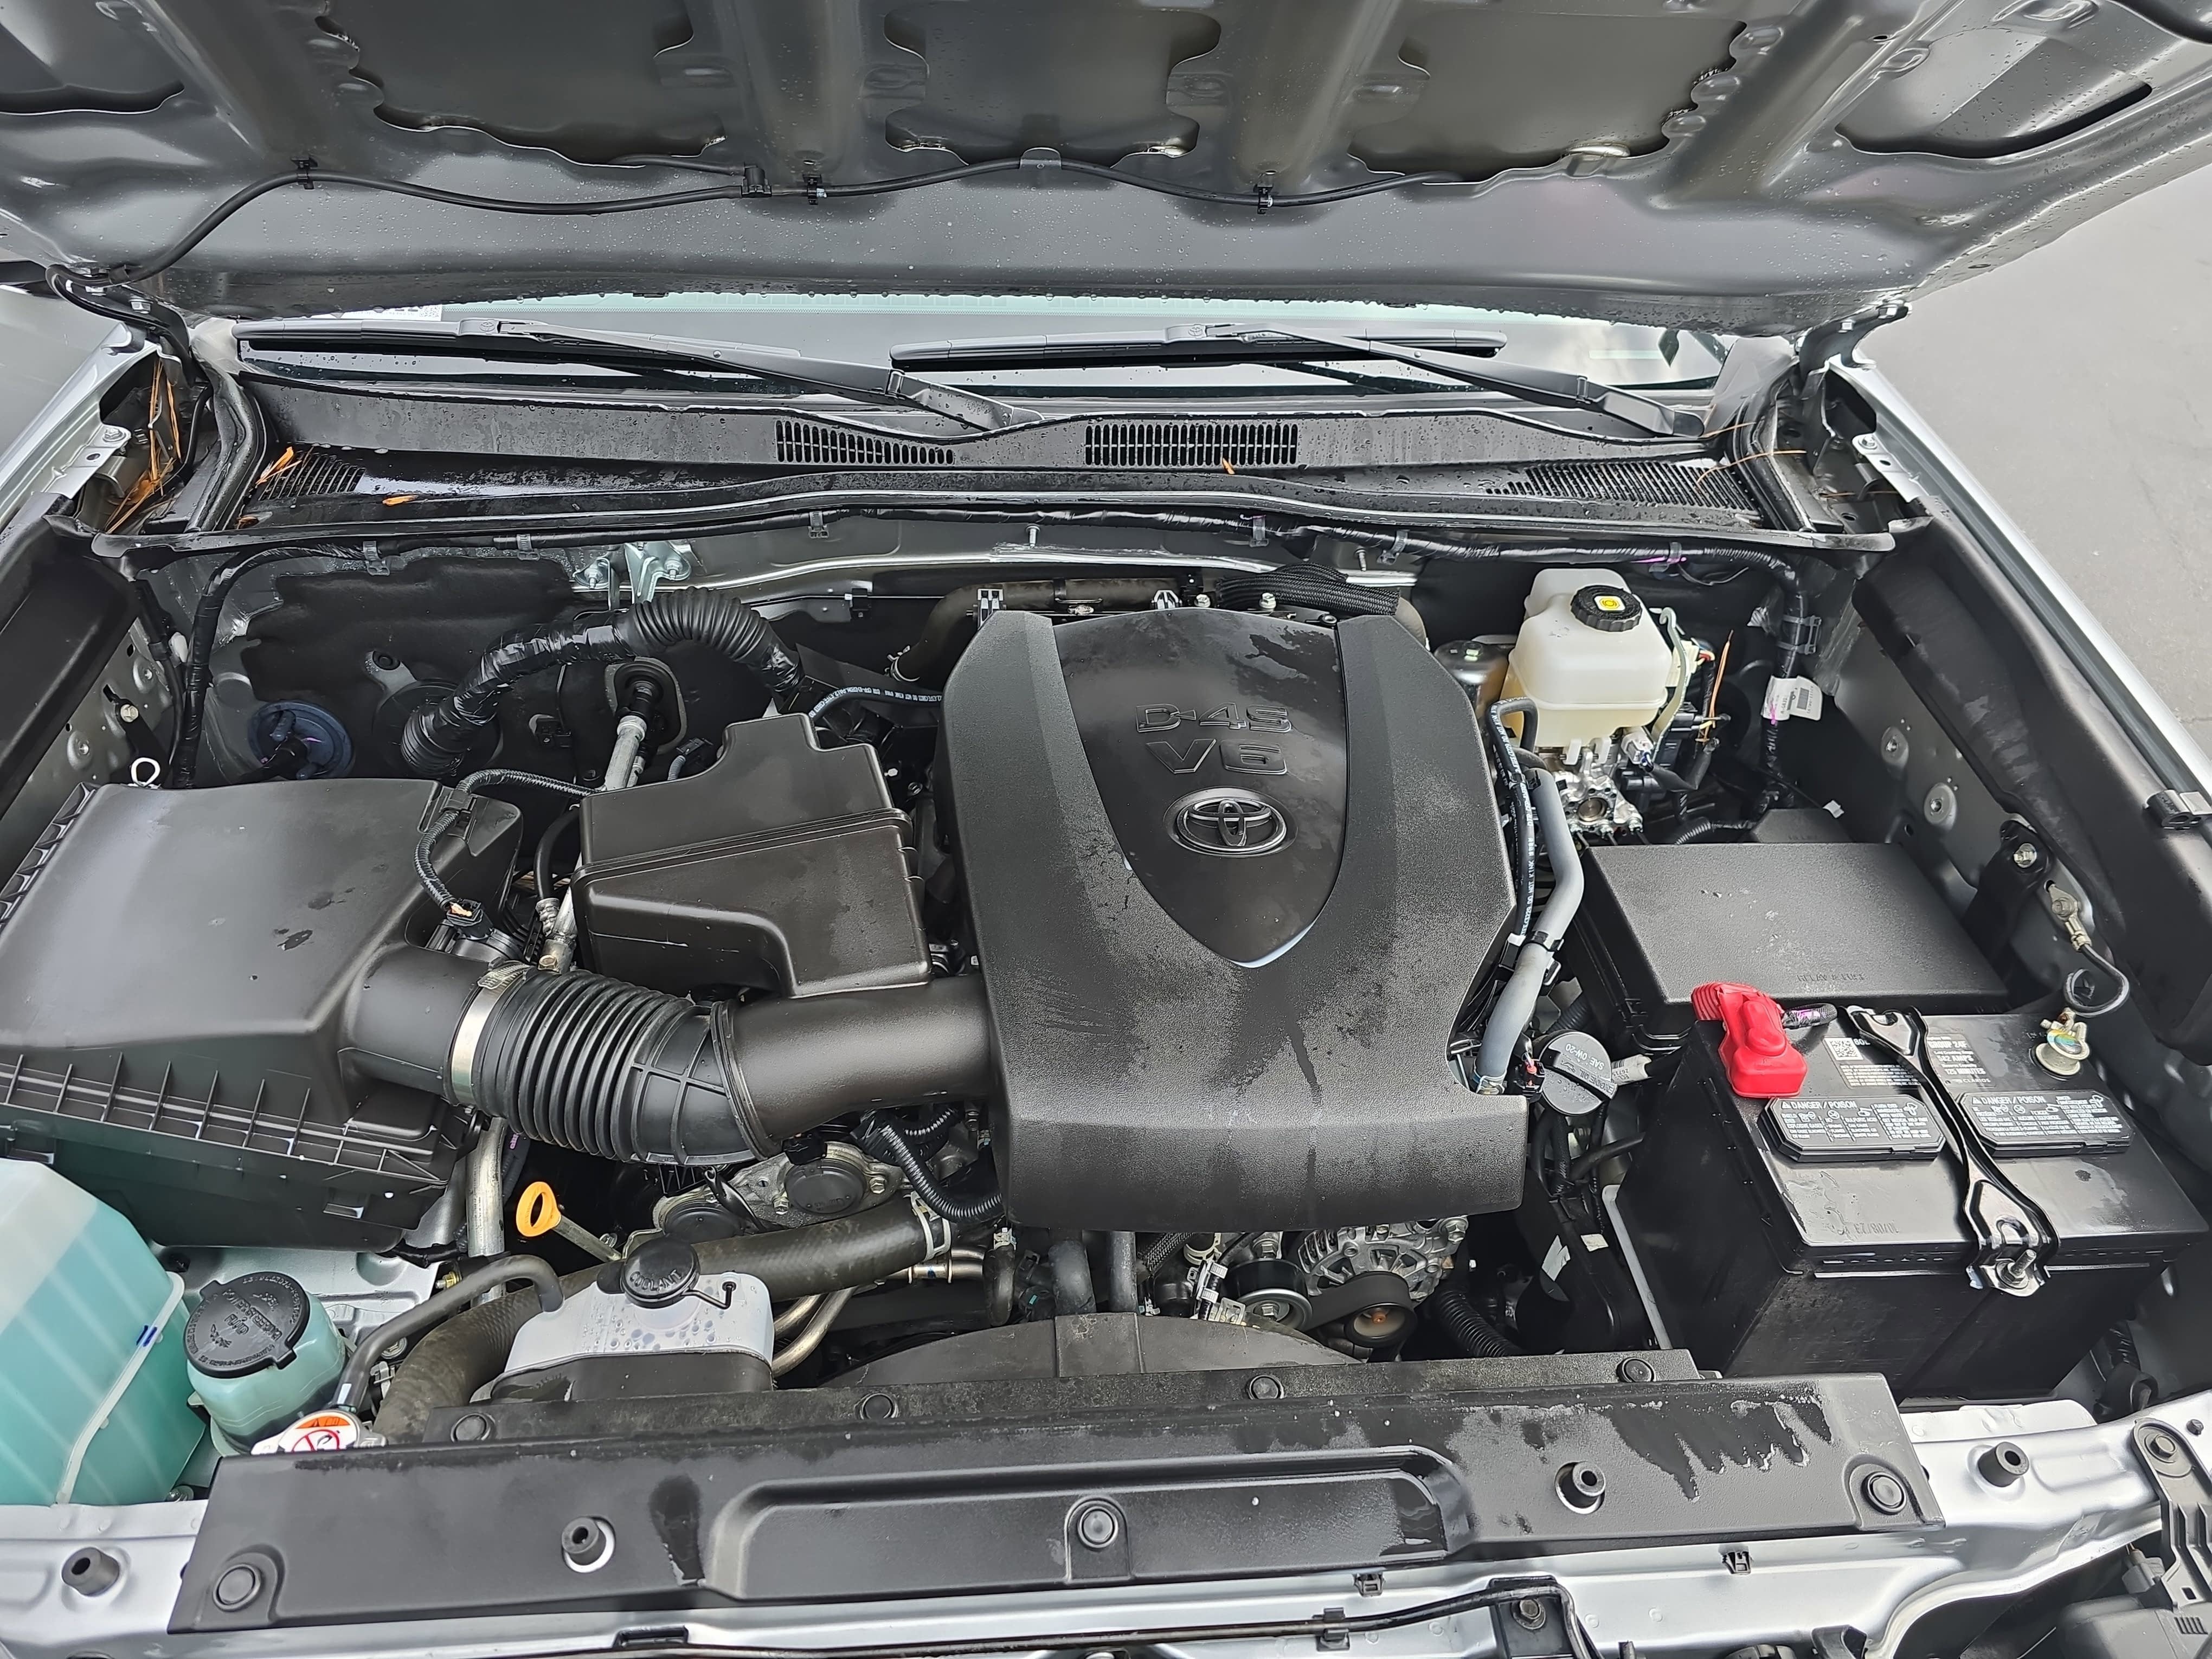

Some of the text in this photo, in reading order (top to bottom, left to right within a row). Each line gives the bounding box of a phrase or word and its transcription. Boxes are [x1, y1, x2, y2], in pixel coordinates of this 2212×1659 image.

[1136, 702, 1292, 733] D-4S
[1146, 738, 1288, 775] V6
[1565, 1043, 1588, 1061] 0W-20
[1790, 1101, 1822, 1109] DANGER
[1828, 1100, 1858, 1109] POISON
[1980, 1096, 2012, 1105] DANGER
[2016, 1096, 2047, 1104] POISON
[629, 1269, 683, 1292] COOLANT
